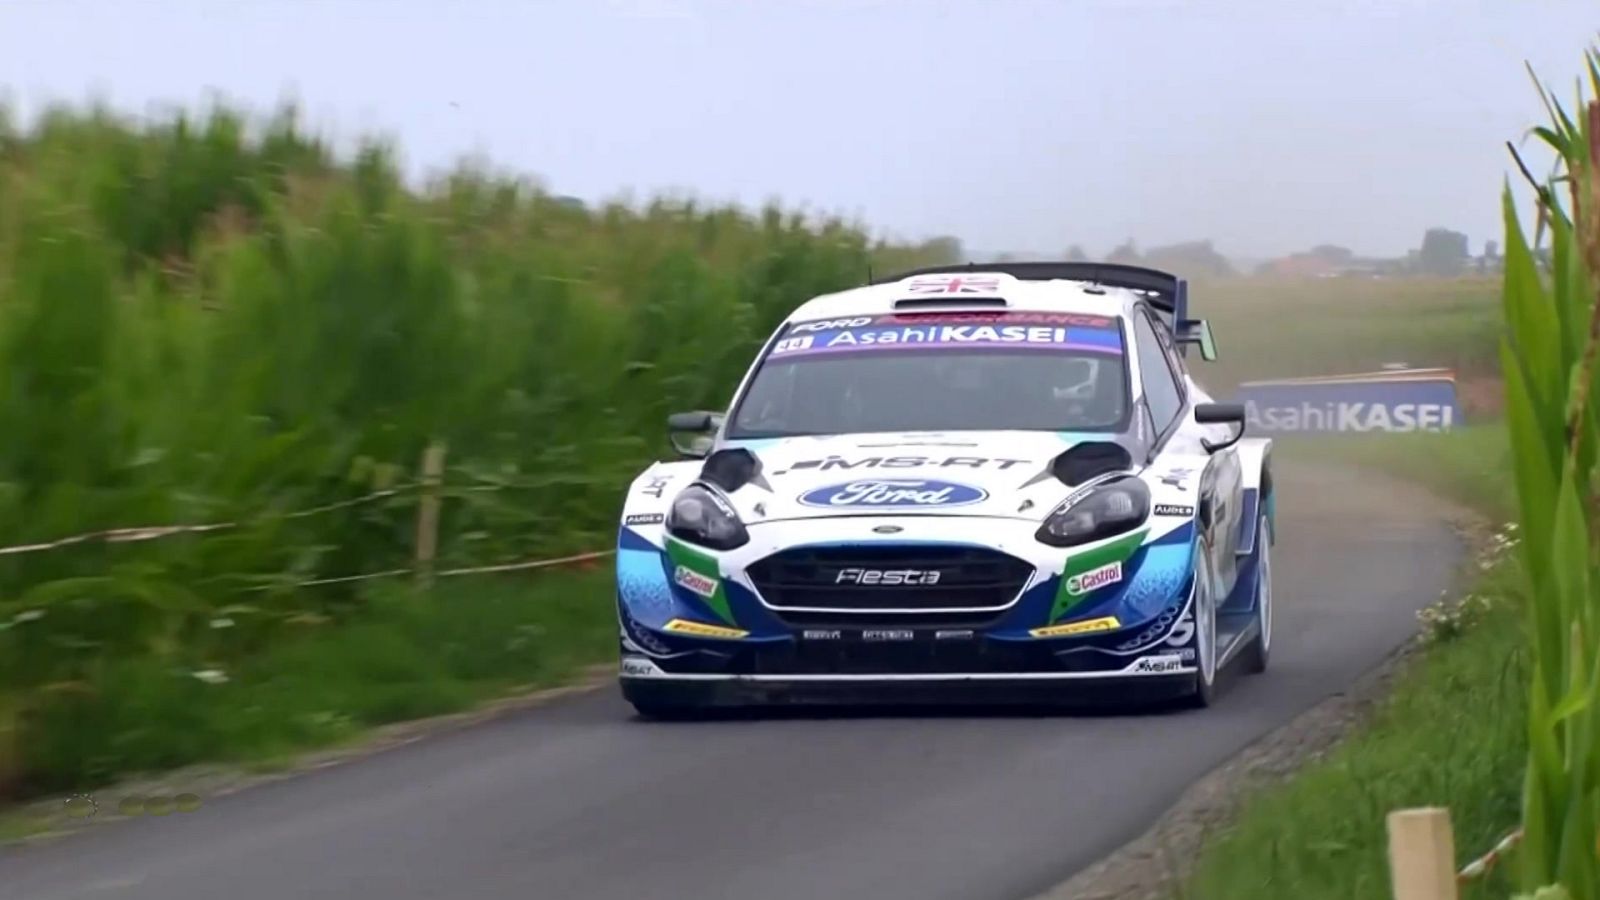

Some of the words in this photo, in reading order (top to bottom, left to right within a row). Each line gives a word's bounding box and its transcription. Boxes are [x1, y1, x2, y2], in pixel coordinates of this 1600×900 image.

[790, 317, 872, 334] FORD
[827, 326, 937, 347] Asahi
[940, 326, 1066, 343] KASEI
[1244, 400, 1335, 431] Asahi
[1338, 402, 1453, 432] KASEI
[830, 481, 955, 505] Ford
[1081, 564, 1120, 589] Castrol
